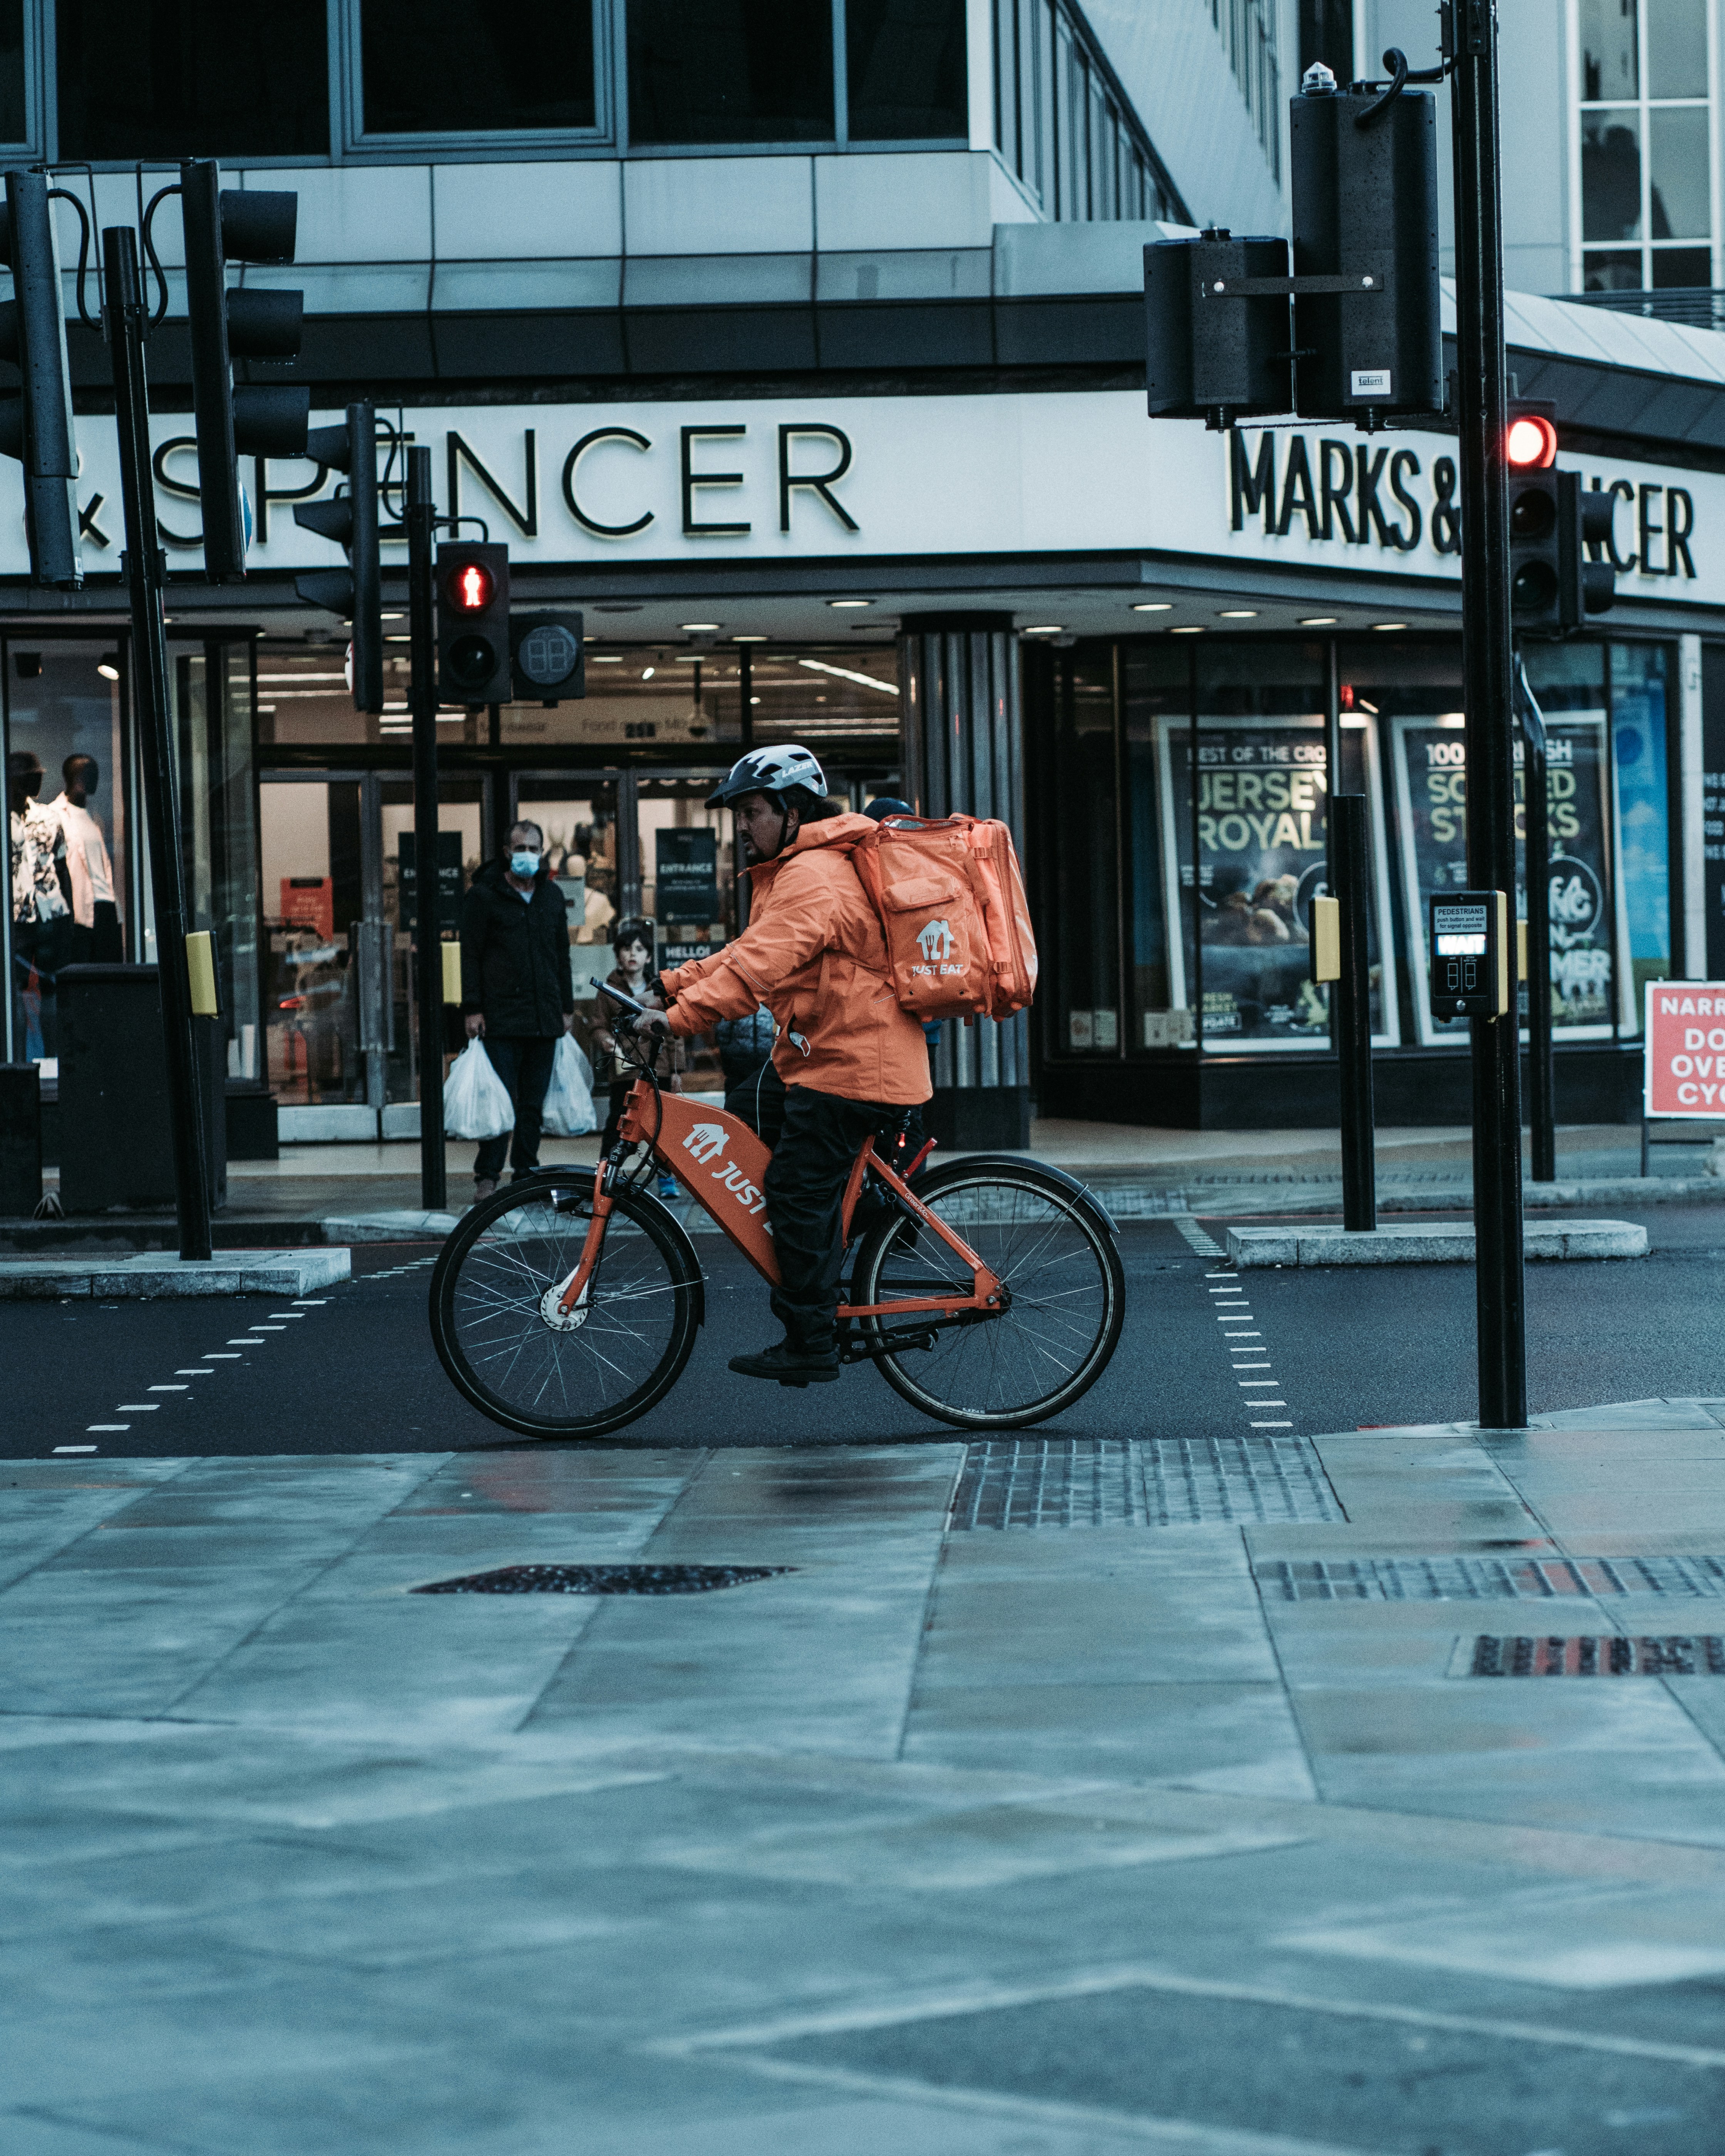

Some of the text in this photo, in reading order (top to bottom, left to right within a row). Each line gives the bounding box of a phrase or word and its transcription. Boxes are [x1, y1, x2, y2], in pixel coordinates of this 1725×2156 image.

[1226, 428, 1422, 551] MARKS
[1430, 455, 1462, 555] &
[1232, 746, 1254, 762] OF
[1258, 745, 1290, 762] THE
[1293, 745, 1326, 762] CRO
[1426, 742, 1465, 766] 100
[782, 761, 813, 778] LAZER
[1198, 812, 1327, 852] ROYAL
[660, 863, 712, 874] ENTRANCE
[1438, 935, 1486, 954] WAIT
[911, 964, 963, 977] JUST EAT
[1661, 996, 1725, 1016] NARR
[1685, 1027, 1725, 1051] DO
[1670, 1054, 1725, 1078] OVE
[711, 1160, 767, 1214] JUST
